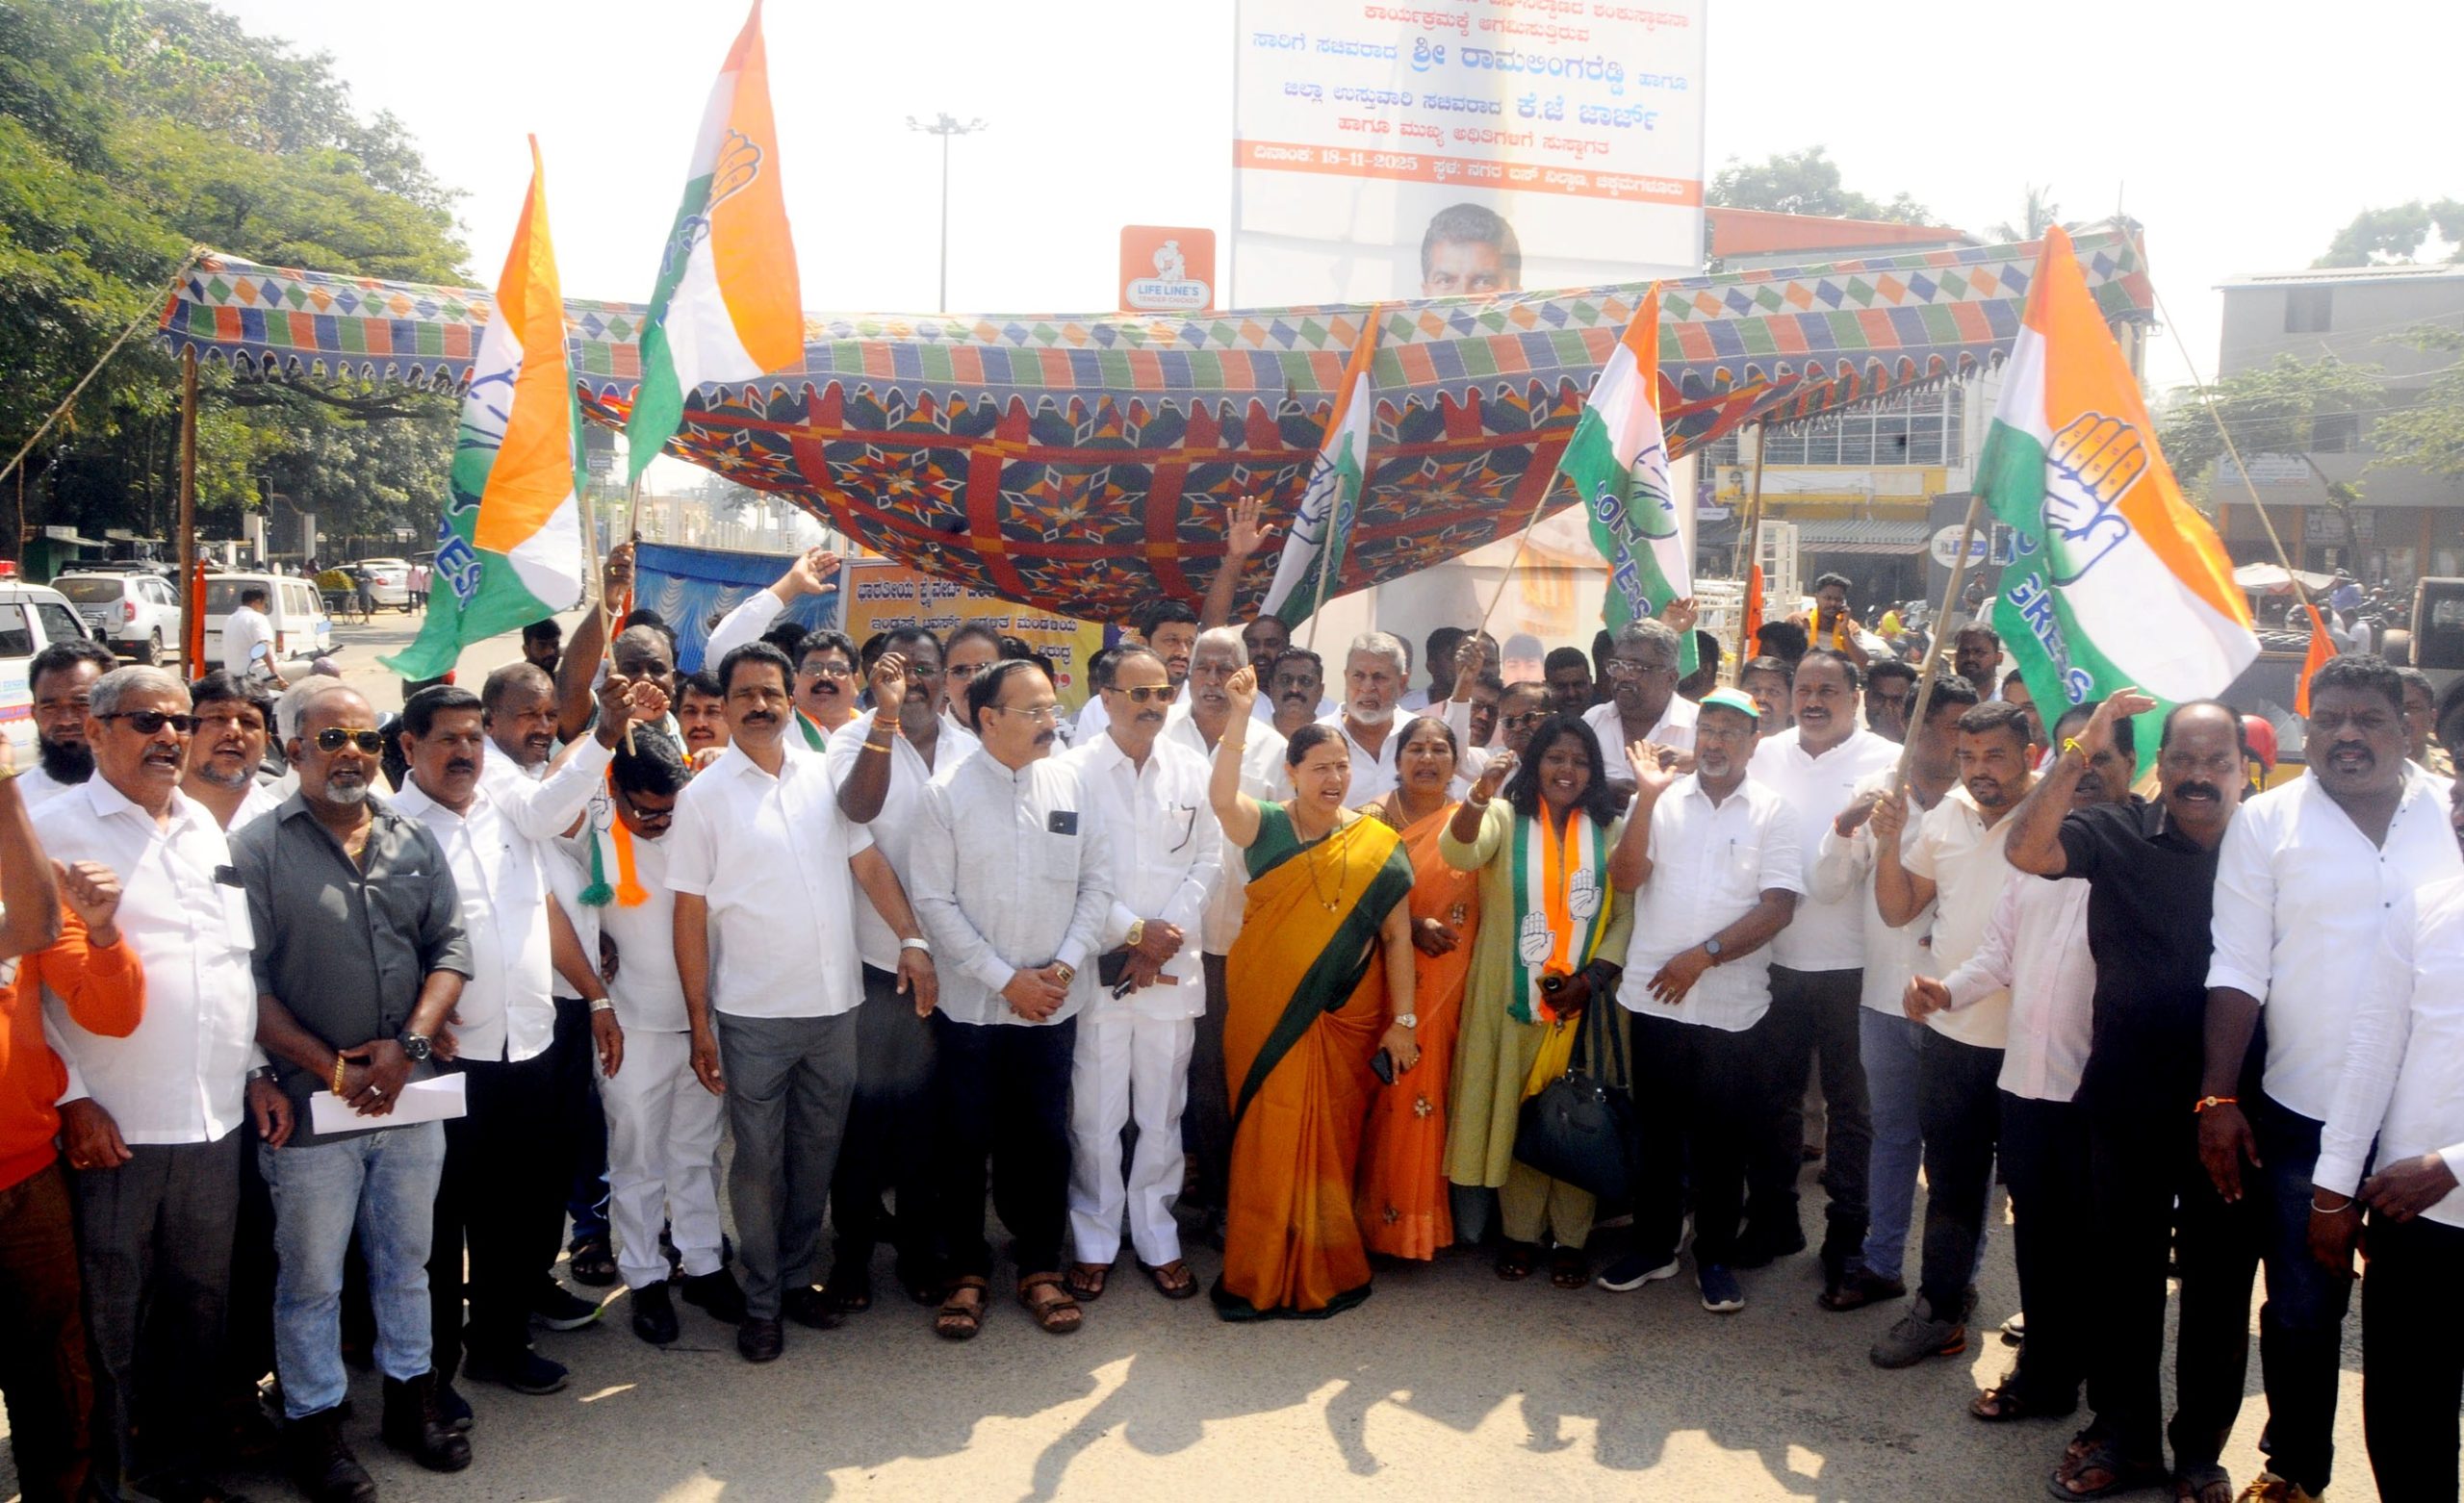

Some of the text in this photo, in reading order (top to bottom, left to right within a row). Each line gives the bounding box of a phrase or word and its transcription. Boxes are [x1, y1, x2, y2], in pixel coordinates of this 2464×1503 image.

[1364, 5, 1471, 38] ಕಾರ್ಯಕ್ರಮಕ್ಕೆ
[1251, 31, 1306, 51] ಸಾರಿಗೆ
[1316, 37, 1398, 60] ಸಚಿವರಾದ
[1410, 37, 1446, 72] ಶ್ರೀ
[1638, 70, 1688, 91] ಹಾಗೂ
[1283, 80, 1323, 104] ಜಿಲ್ಲಾ
[1333, 84, 1413, 109] ಉಸ್ತುವಾರಿ
[1423, 94, 1502, 116] ಸಚಿವರಾದ
[1338, 116, 1392, 135] ಹಾಗೂ
[1399, 121, 1446, 147] ಮುಖ್ಯ
[1321, 149, 1419, 171] 18-11-2025
[1138, 284, 1199, 296] LIFE LINE'S
